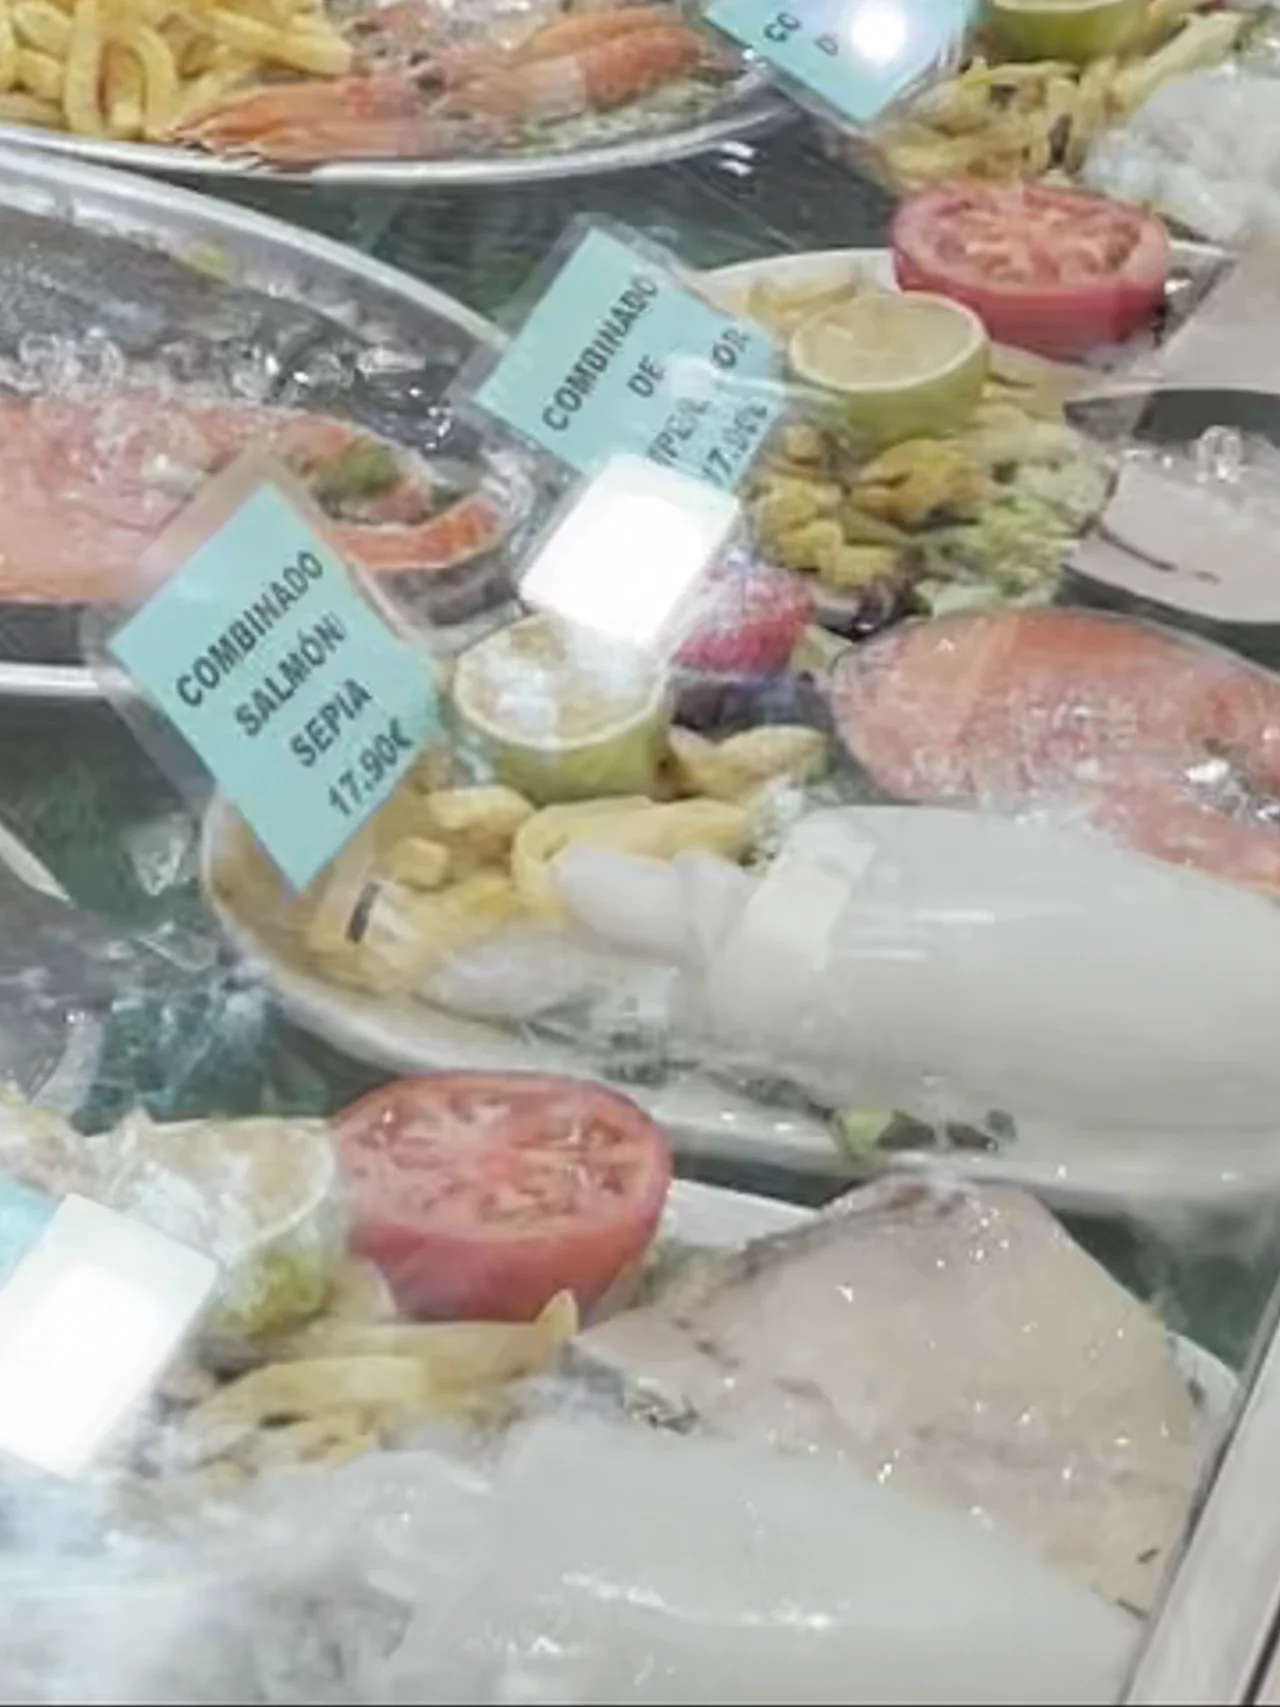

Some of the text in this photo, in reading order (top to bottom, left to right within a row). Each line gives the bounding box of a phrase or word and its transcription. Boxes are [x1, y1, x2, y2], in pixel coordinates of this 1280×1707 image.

[542, 278, 659, 432] COMBINADO
[176, 550, 325, 708] COMBINADO
[289, 678, 373, 768] SEPIA
[327, 717, 414, 817] 17.90€
